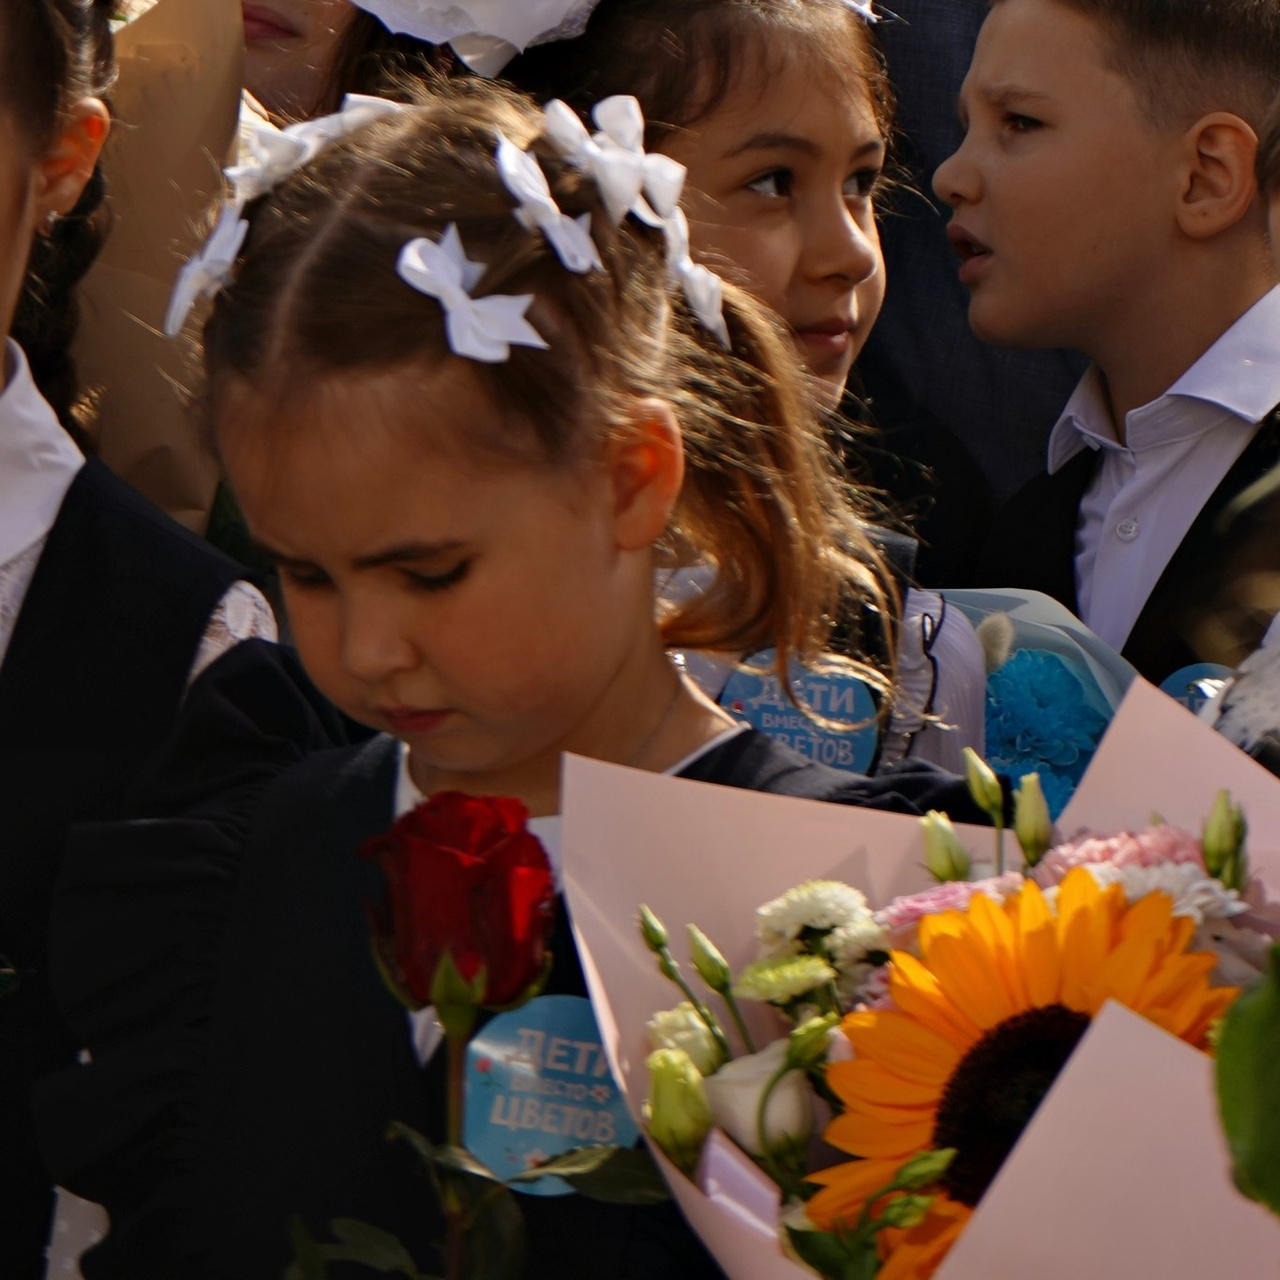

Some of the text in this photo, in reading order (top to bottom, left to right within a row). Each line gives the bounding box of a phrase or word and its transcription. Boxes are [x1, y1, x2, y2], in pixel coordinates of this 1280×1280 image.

[762, 712, 850, 732] ВМЕС
[764, 732, 855, 766] ЕТОВ
[490, 1095, 616, 1141] ЦВЕТОВ
